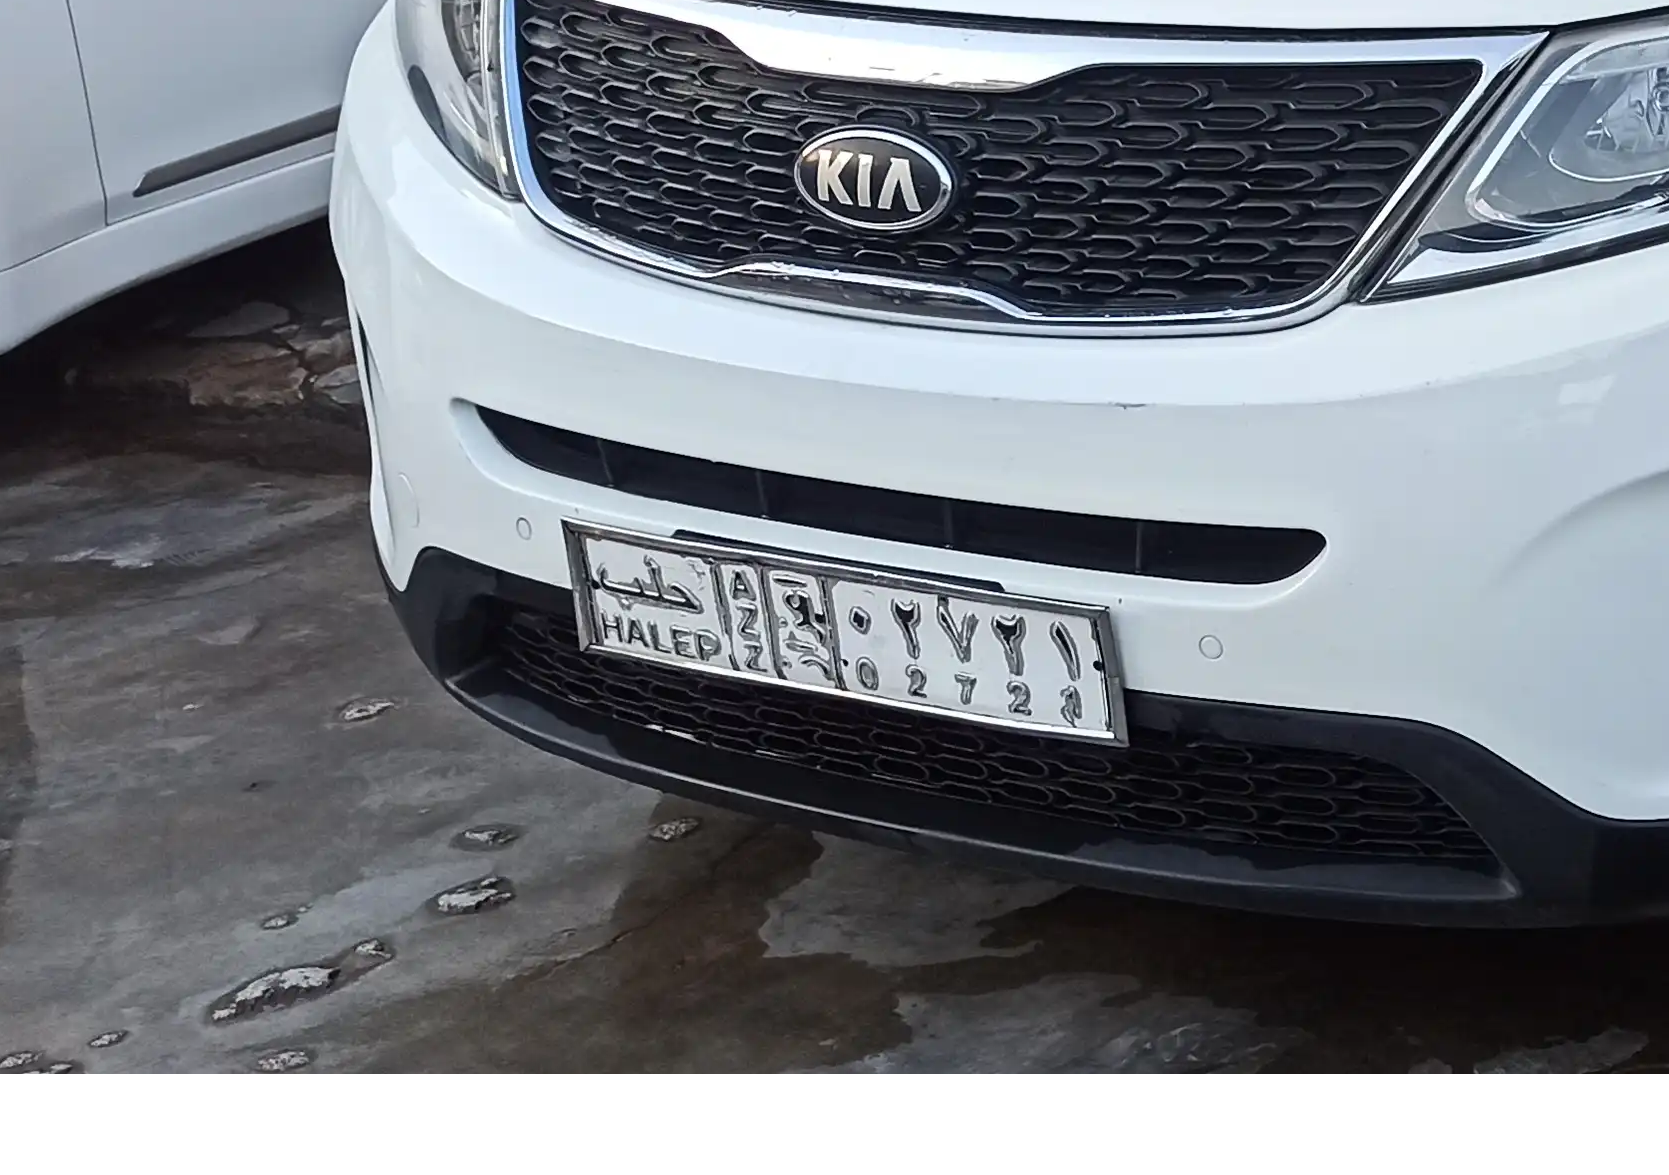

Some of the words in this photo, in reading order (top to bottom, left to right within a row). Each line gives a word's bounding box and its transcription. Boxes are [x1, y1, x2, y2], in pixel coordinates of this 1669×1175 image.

[816, 148, 922, 213] KIA
[596, 554, 705, 614] حلب
[600, 609, 722, 661] HALEP
[849, 598, 1081, 681] ٠٢٧٢١
